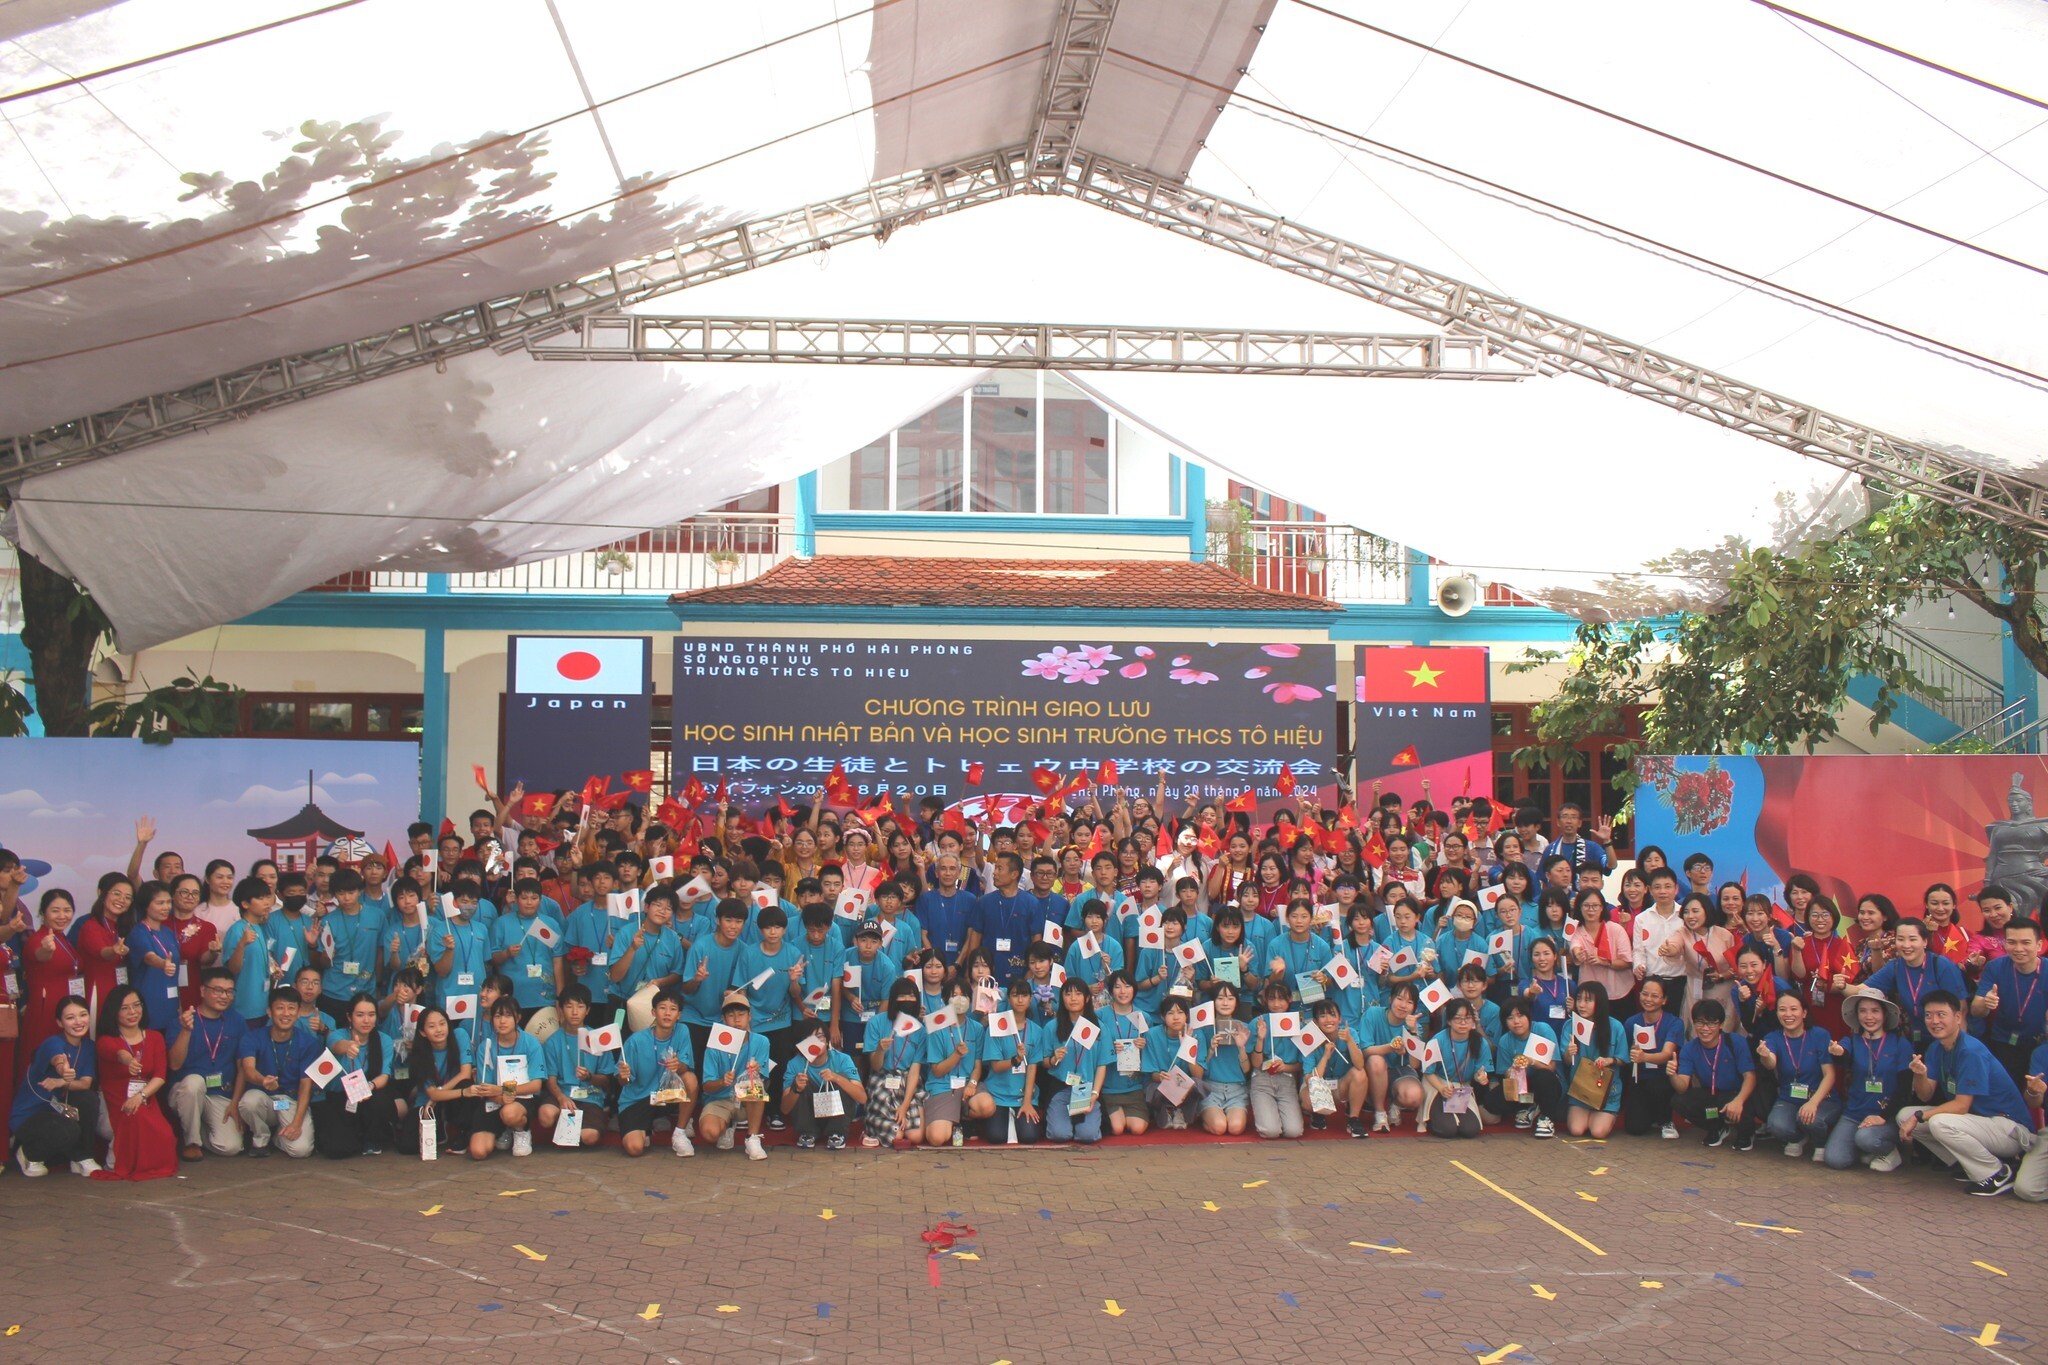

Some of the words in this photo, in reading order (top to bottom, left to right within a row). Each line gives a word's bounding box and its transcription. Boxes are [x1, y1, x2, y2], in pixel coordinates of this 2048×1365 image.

[684, 642, 735, 653] UBND
[820, 642, 855, 654] PHỐ
[719, 654, 777, 666] NGOẠI
[788, 655, 812, 666] VỤ
[684, 665, 759, 676] TRƯỜNG
[771, 667, 819, 677] THCS
[830, 666, 853, 677] TÔ
[865, 667, 909, 679] HIỆU
[527, 697, 627, 709] Japan
[864, 698, 966, 717] CHƯƠNG
[972, 695, 1038, 717] TRÌNH
[1044, 700, 1102, 717] GIAO
[1108, 700, 1151, 718] LƯU
[1373, 706, 1419, 718] Viet
[1433, 707, 1477, 718] Nam
[684, 724, 736, 746] HỌC
[743, 724, 794, 742] SINH
[801, 721, 862, 746] NHẬT
[869, 721, 915, 743] BẢN
[922, 722, 952, 743] VÀ
[959, 726, 1011, 748] HỌC
[1017, 727, 1067, 744] SINH
[1074, 723, 1168, 745] TRƯỜNG
[1174, 728, 1232, 745] THCS
[1239, 725, 1268, 745] TÔ
[1274, 725, 1323, 749] HIỆU
[1287, 784, 1317, 798] 024
[863, 922, 878, 930] GAP
